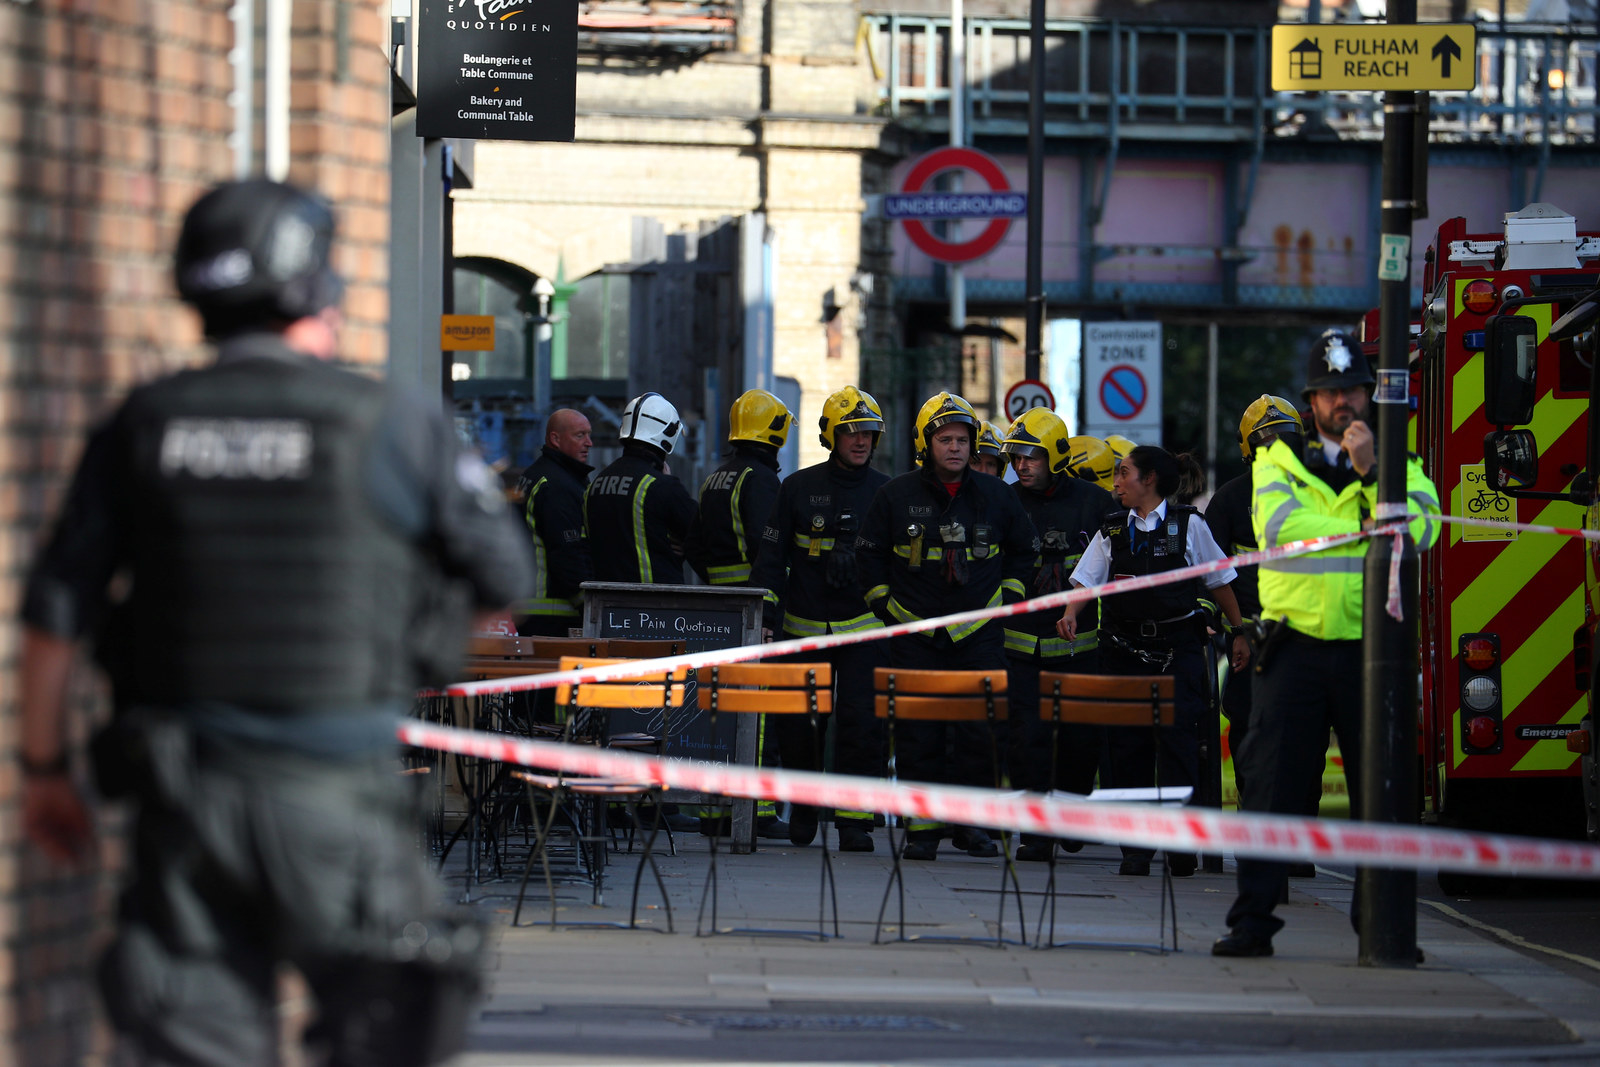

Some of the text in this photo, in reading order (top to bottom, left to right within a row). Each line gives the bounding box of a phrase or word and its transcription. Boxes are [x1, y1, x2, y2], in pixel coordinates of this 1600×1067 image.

[446, 20, 551, 32] QUOTIDIEN
[1334, 39, 1418, 55] FULHAM
[463, 53, 532, 66] Boulangerie et
[460, 68, 533, 80] Table Commune
[1344, 61, 1408, 77] REACH
[470, 95, 522, 108] Bakery and
[457, 109, 534, 122] Communal Table
[887, 196, 1025, 214] UNDERGROUND
[445, 326, 491, 336] amazon
[1091, 327, 1155, 341] Controlled
[1100, 345, 1147, 361] ZONE
[160, 420, 311, 479] POLICE
[590, 476, 633, 495] FIRE
[1522, 728, 1580, 739] Emergen
